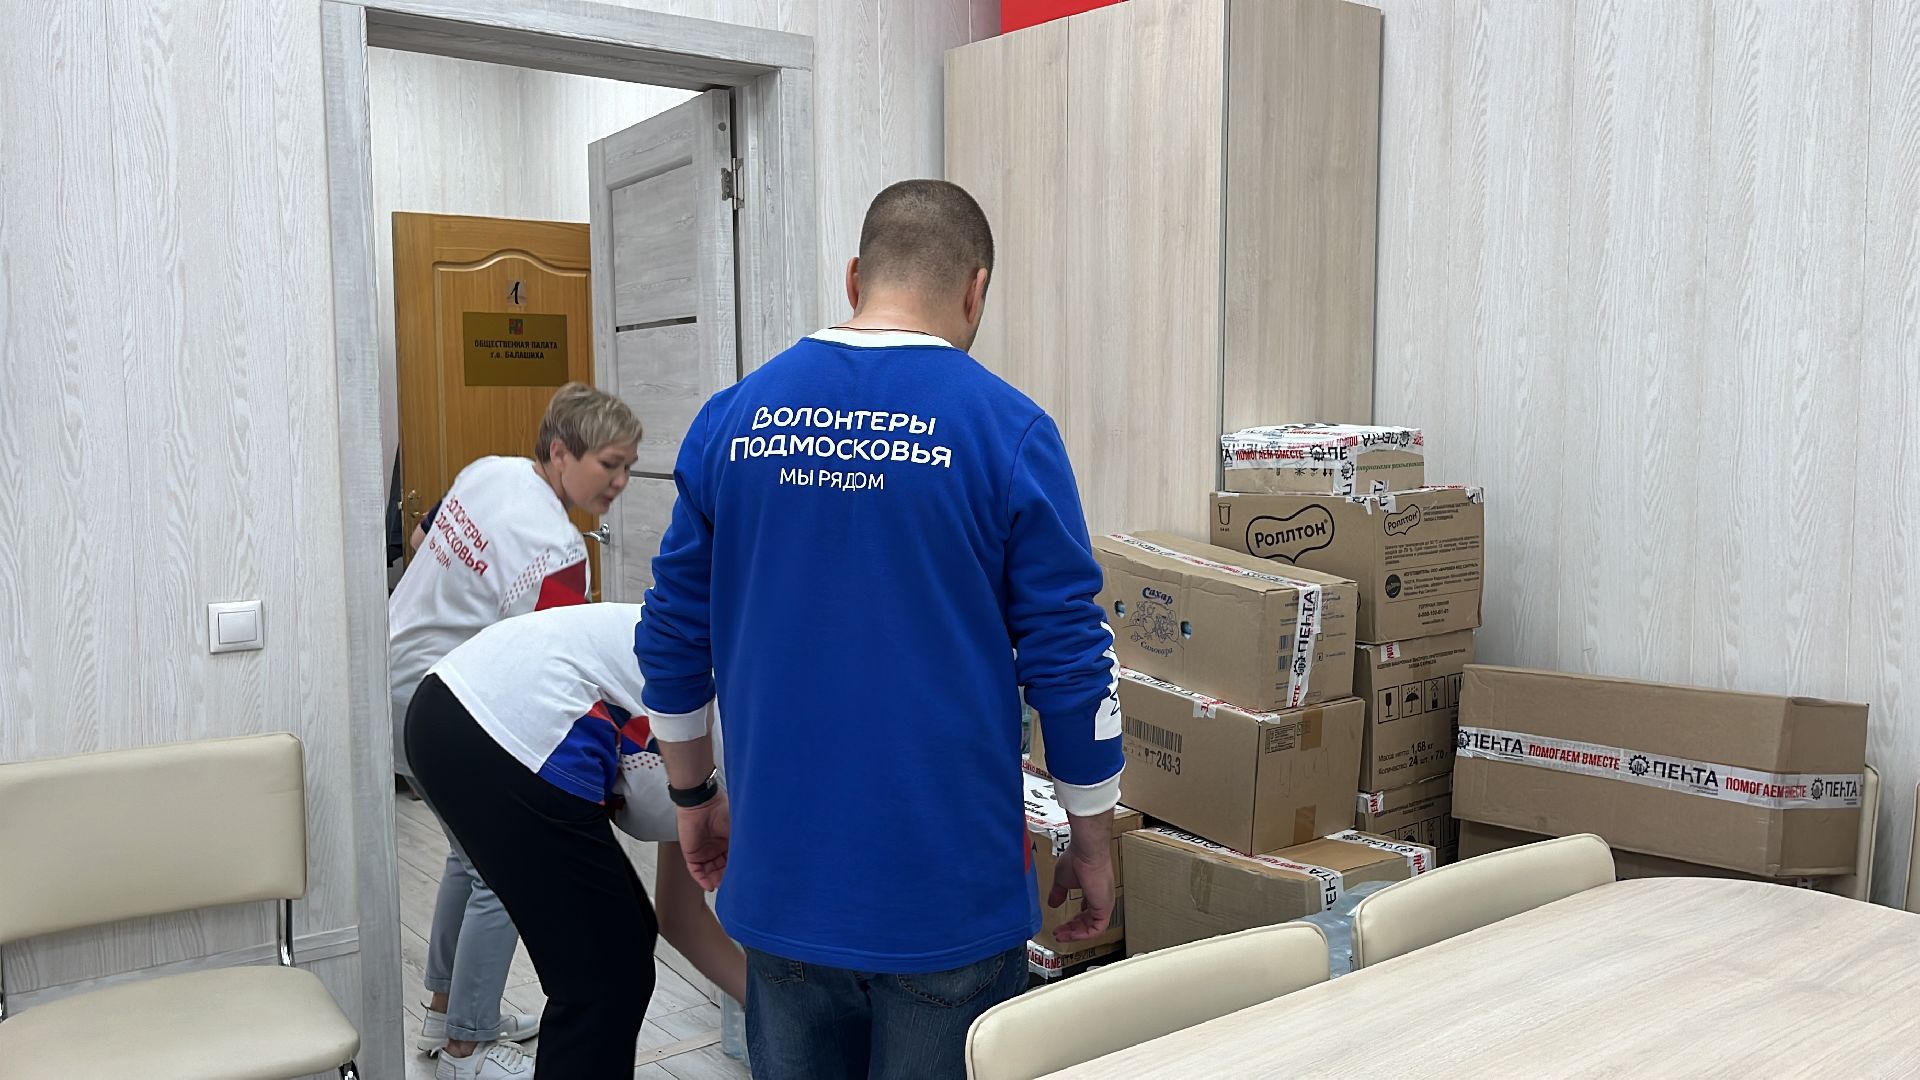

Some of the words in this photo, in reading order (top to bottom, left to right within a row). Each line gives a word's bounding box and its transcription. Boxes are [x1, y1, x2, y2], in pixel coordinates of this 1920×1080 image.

[510, 281, 520, 305] 1
[474, 339, 530, 349] ОБЩЕСТВЕННАЯ
[531, 341, 558, 349] ПАЛАТА
[504, 351, 545, 359] БАЛАШИХА
[751, 406, 937, 435] ВОЛОНТЕРЫ
[729, 434, 952, 468] ПОДМОСКОВЬЯ
[779, 467, 814, 486] МЫ
[818, 469, 885, 491] РЯДОМ
[1142, 587, 1173, 605] Сахар
[1411, 741, 1426, 754] 1,68
[1409, 756, 1418, 767] 24
[1528, 744, 1580, 764] ПОМОГАЕМ
[1582, 754, 1621, 771] ВМЕСТЕ
[1653, 760, 1719, 787] ПЕНТА
[1725, 776, 1784, 798] ПОМОГАЕМ
[1784, 784, 1807, 798] ВМЕСТЕ
[1825, 781, 1858, 798] ПЕНТА
[1309, 867, 1338, 910] ЕНТА
